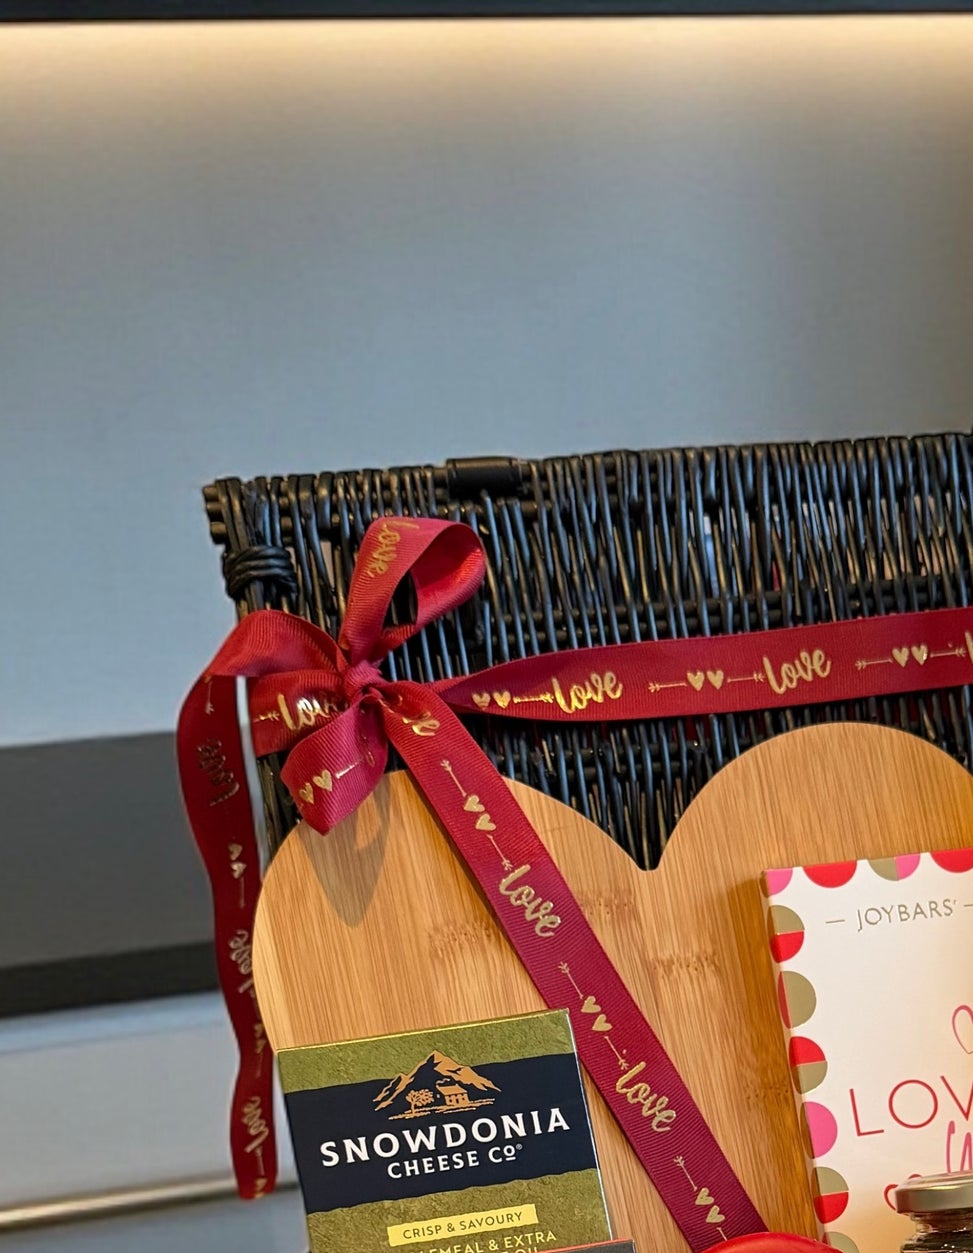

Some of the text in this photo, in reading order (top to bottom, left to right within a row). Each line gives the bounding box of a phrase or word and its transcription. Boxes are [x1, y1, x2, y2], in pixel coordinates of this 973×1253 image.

[551, 671, 623, 714] love
[763, 648, 832, 695] love
[499, 863, 562, 937] love
[616, 1061, 677, 1133] love
[320, 1107, 570, 1168] SNOWDONIA
[387, 1150, 480, 1179] CHEESE
[402, 1211, 523, 1240] CRISP & SAVOURY
[488, 1238, 500, 1252] &
[504, 1230, 557, 1250] EXTRA
